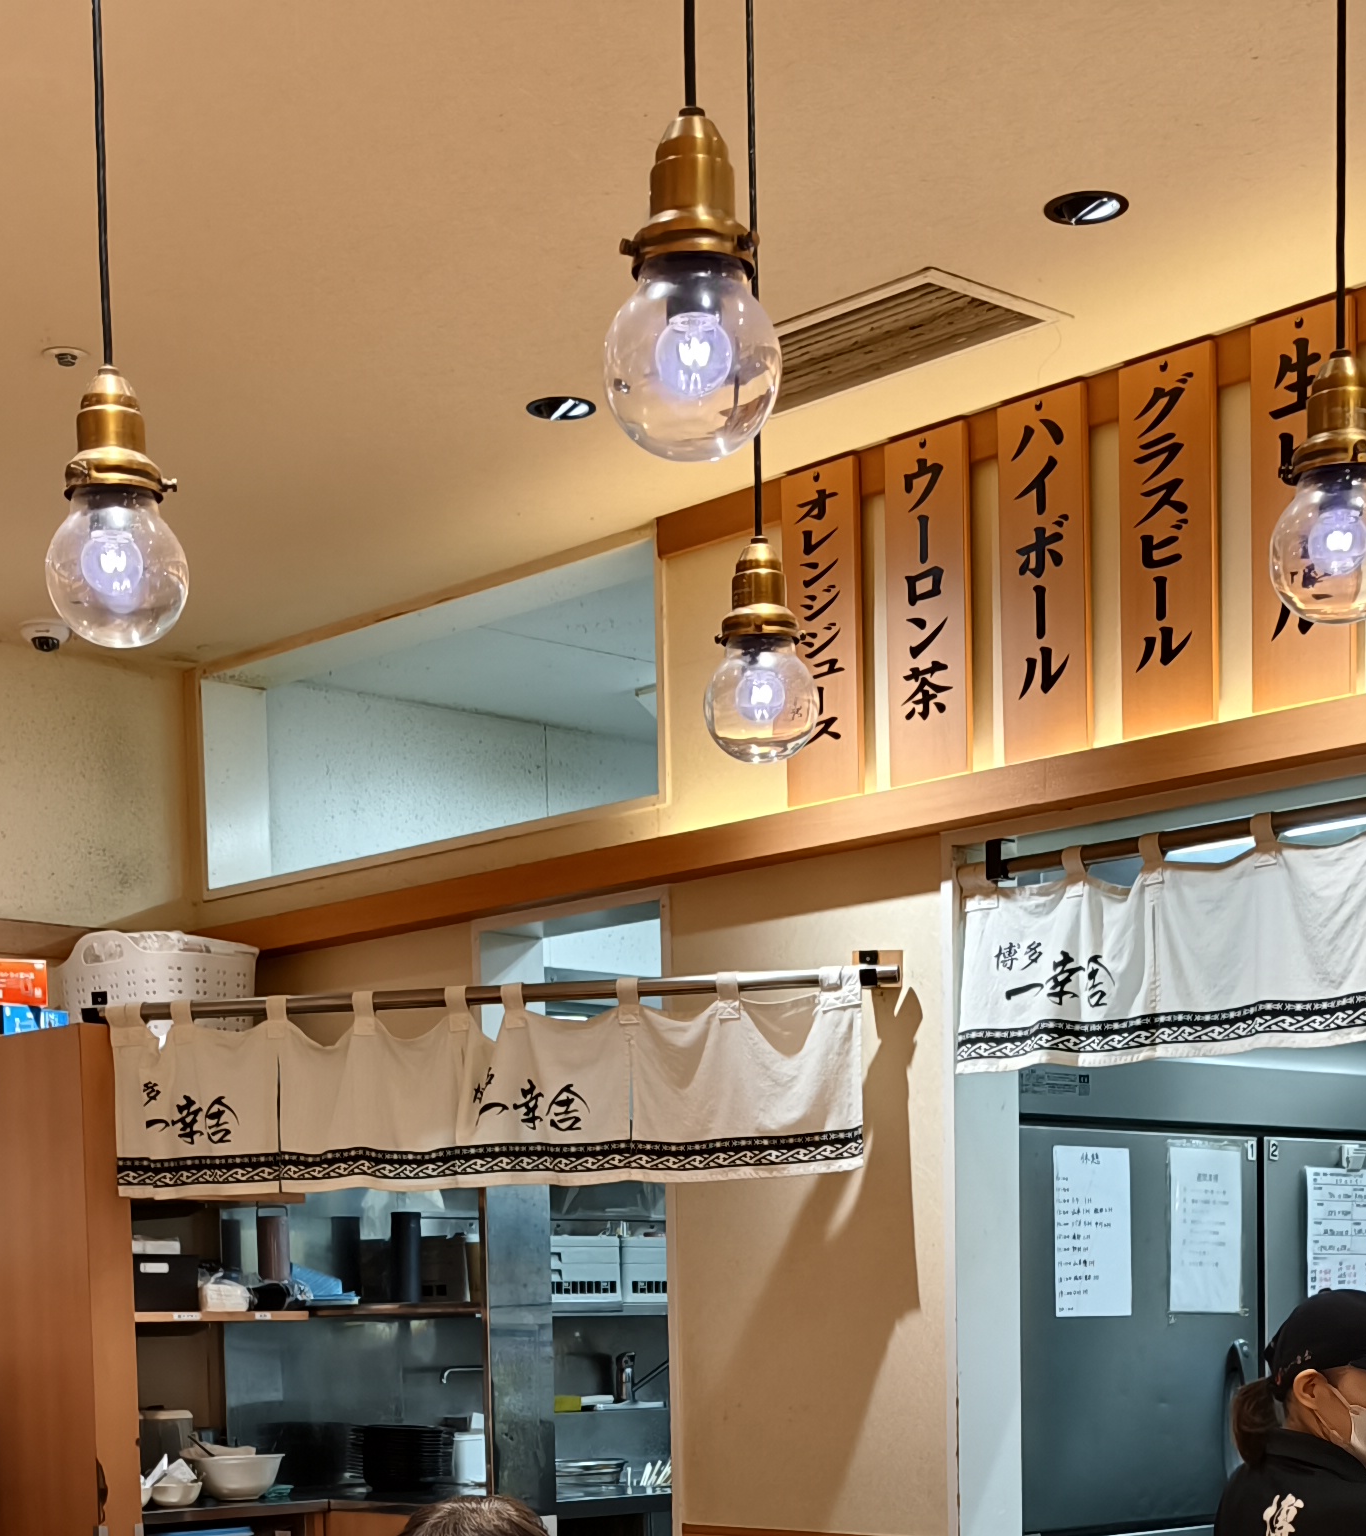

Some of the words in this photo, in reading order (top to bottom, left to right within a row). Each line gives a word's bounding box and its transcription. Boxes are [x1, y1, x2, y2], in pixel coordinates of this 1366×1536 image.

[794, 486, 842, 746] オレンジジュース
[902, 458, 953, 721] ウーロン茶
[1011, 416, 1070, 701] ハイボール
[1134, 371, 1193, 674] グラスビール
[994, 941, 1044, 972] 博多
[1249, 1143, 1255, 1158] 1
[1271, 1144, 1278, 1158] 2
